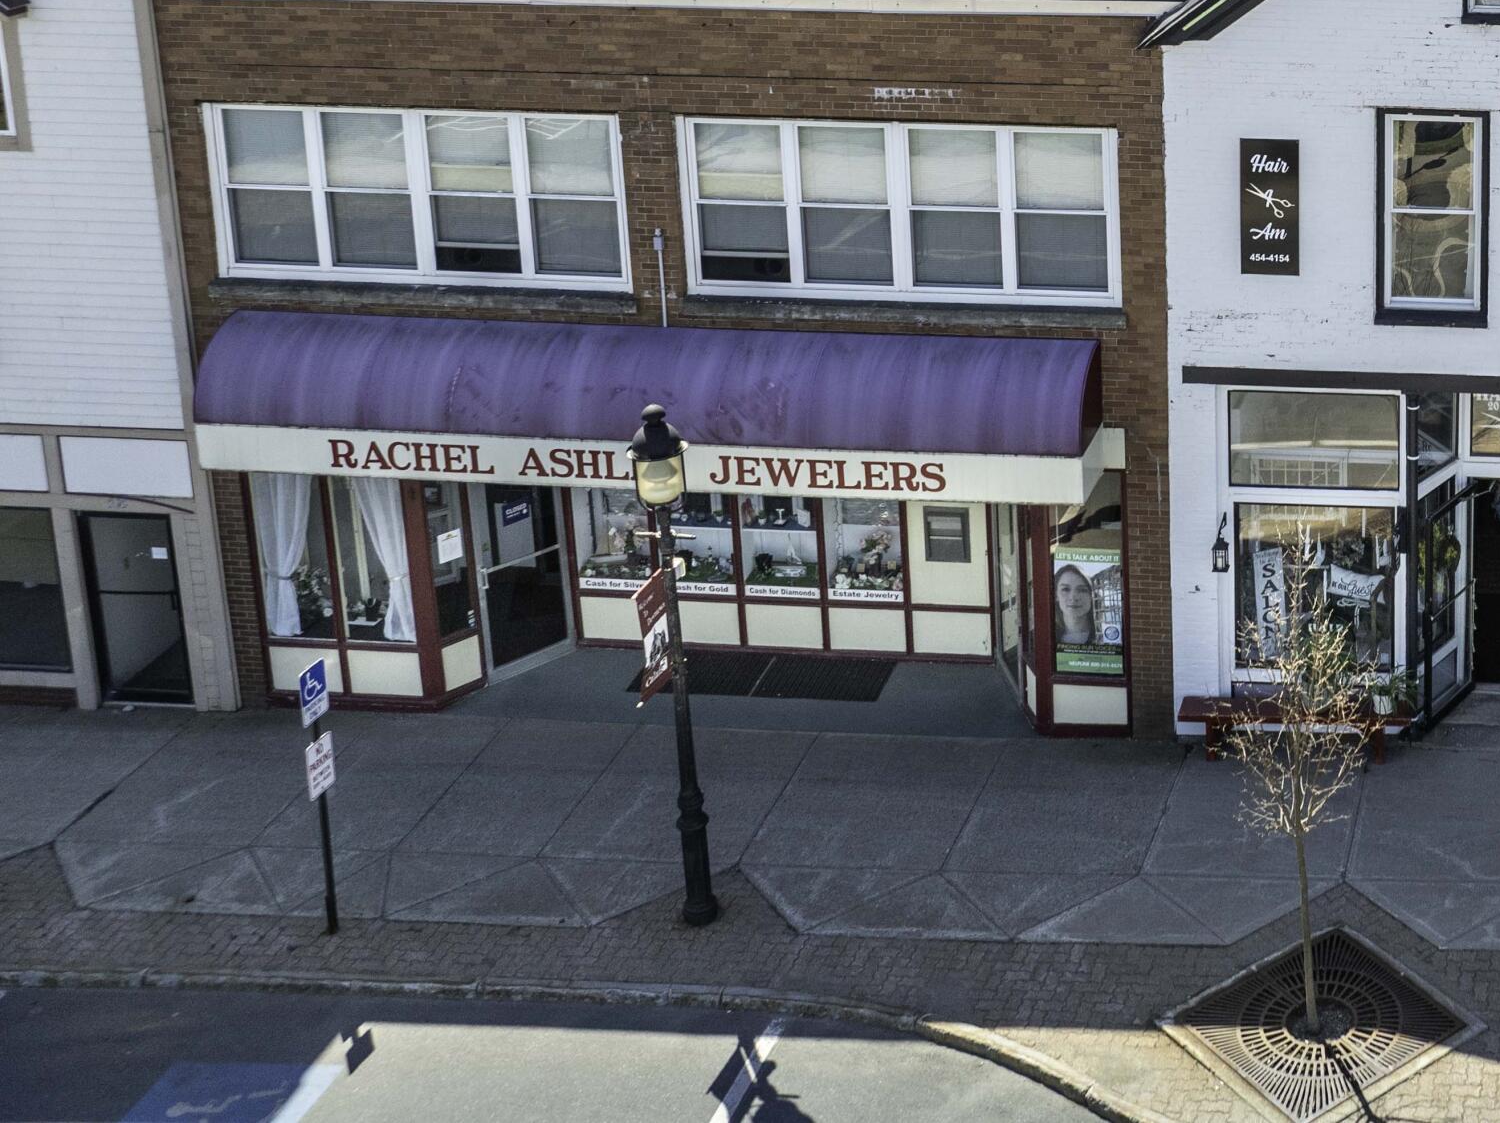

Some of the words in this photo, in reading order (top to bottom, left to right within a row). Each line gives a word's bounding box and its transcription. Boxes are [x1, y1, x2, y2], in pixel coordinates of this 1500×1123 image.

[1250, 154, 1290, 173] Hair
[1250, 222, 1288, 241] Am
[1249, 253, 1290, 263] 454-4154
[328, 439, 494, 475] RACHEL
[518, 448, 637, 480] ASHL
[710, 456, 947, 492] JEWELERS
[585, 579, 607, 587] Cash
[609, 580, 621, 588] for
[624, 581, 642, 589] Silve
[694, 585, 707, 593] for
[709, 585, 729, 593] Gold
[749, 587, 767, 595] Cash
[781, 589, 816, 597] Diamonds
[833, 590, 861, 598] Estate
[864, 591, 899, 600] Jewelry
